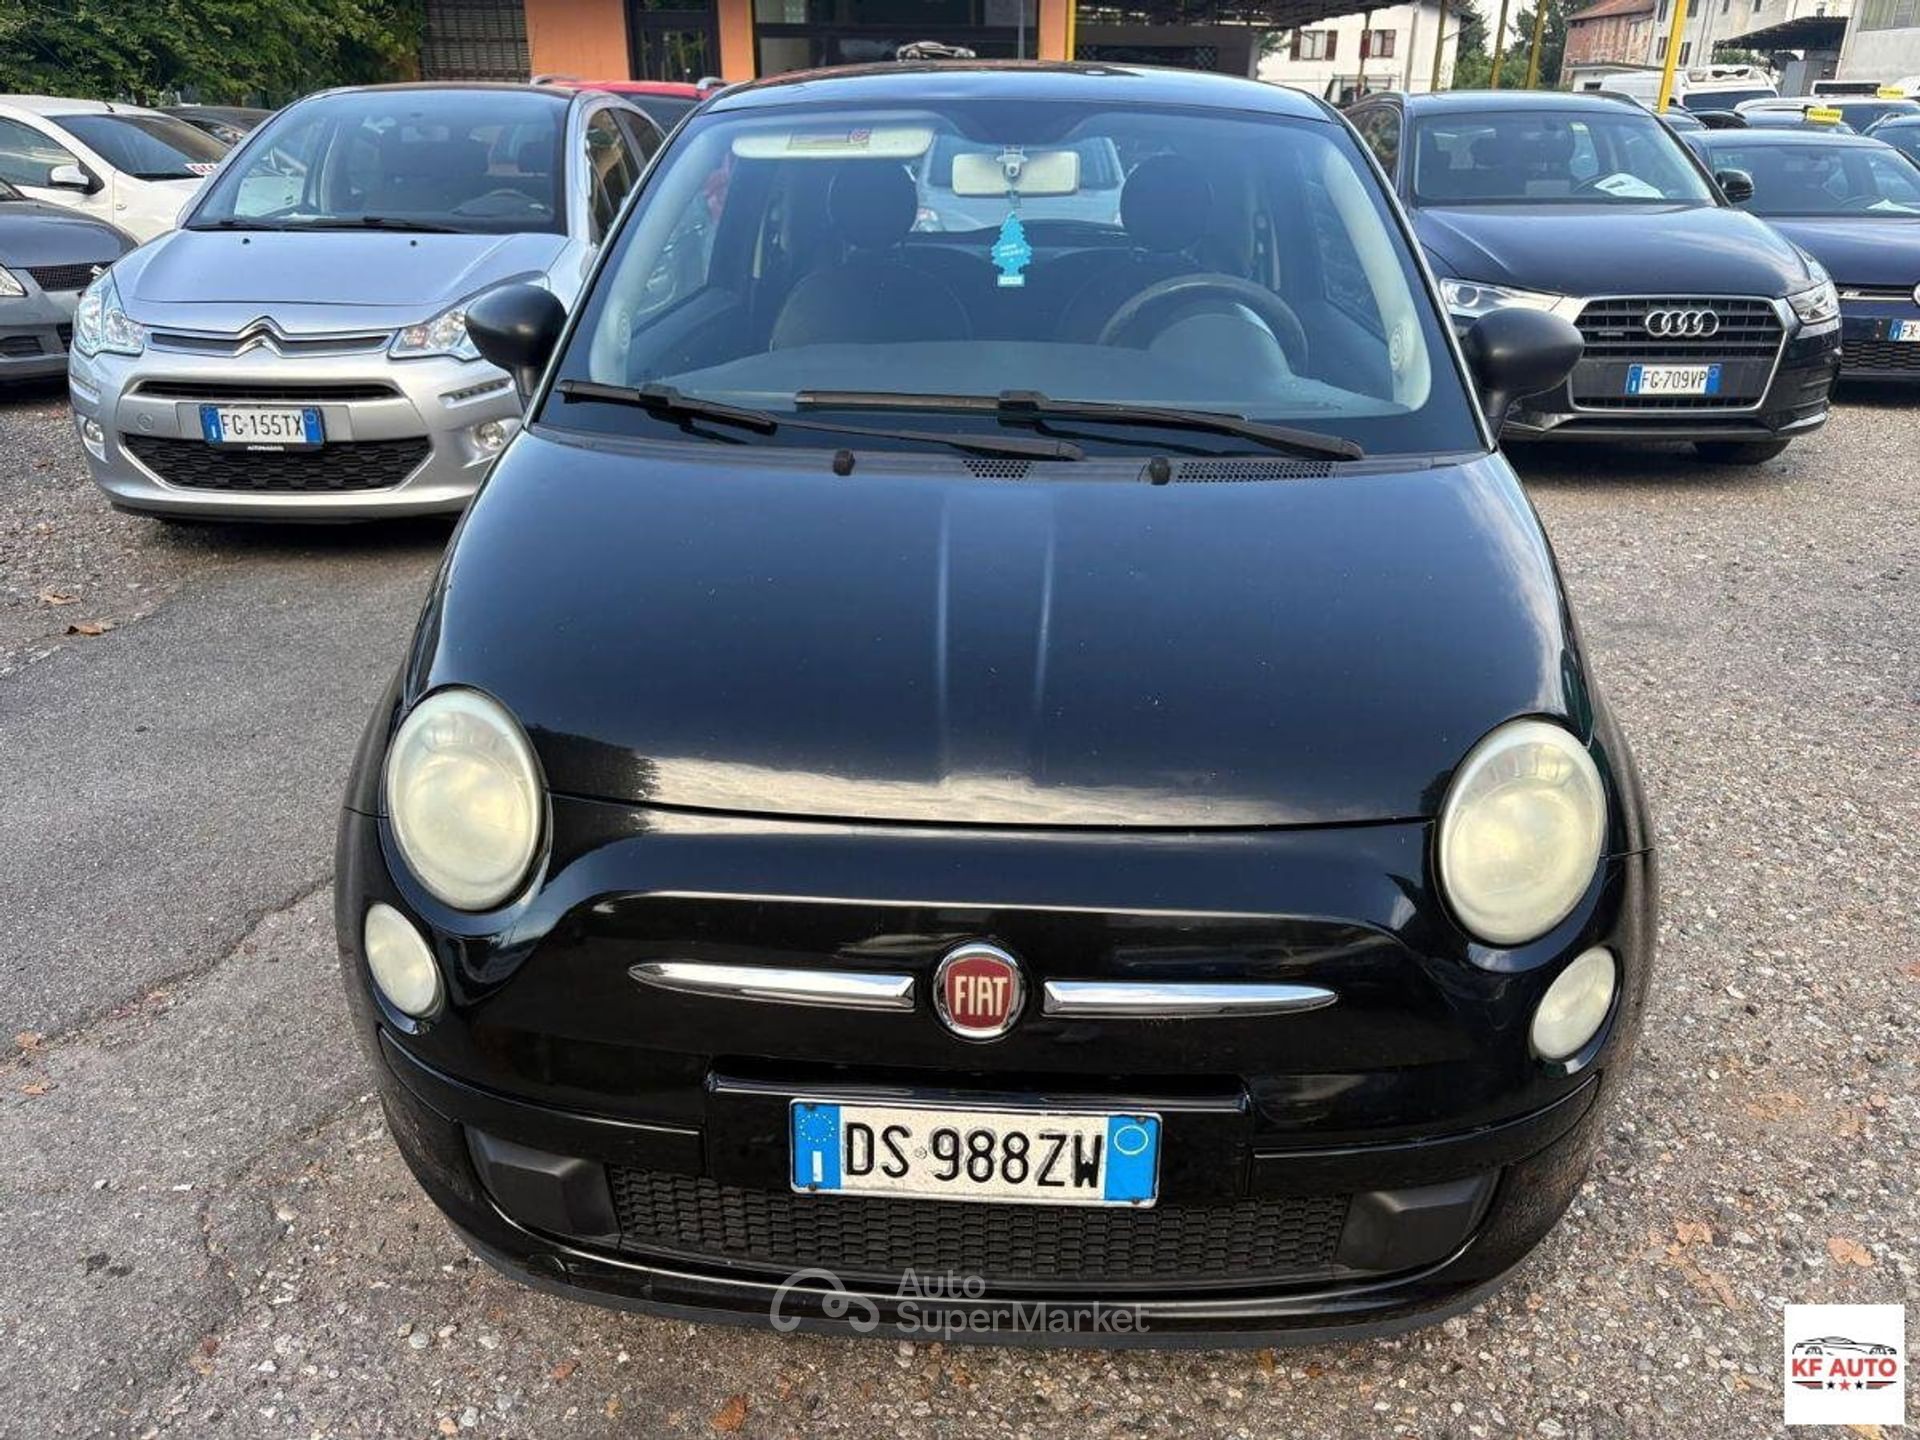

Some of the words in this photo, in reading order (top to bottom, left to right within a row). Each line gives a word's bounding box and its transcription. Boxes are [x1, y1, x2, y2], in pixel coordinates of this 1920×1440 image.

[955, 975, 1008, 1016] FIAT
[845, 1122, 912, 1179] DS
[931, 1127, 1104, 1188] 988ZW
